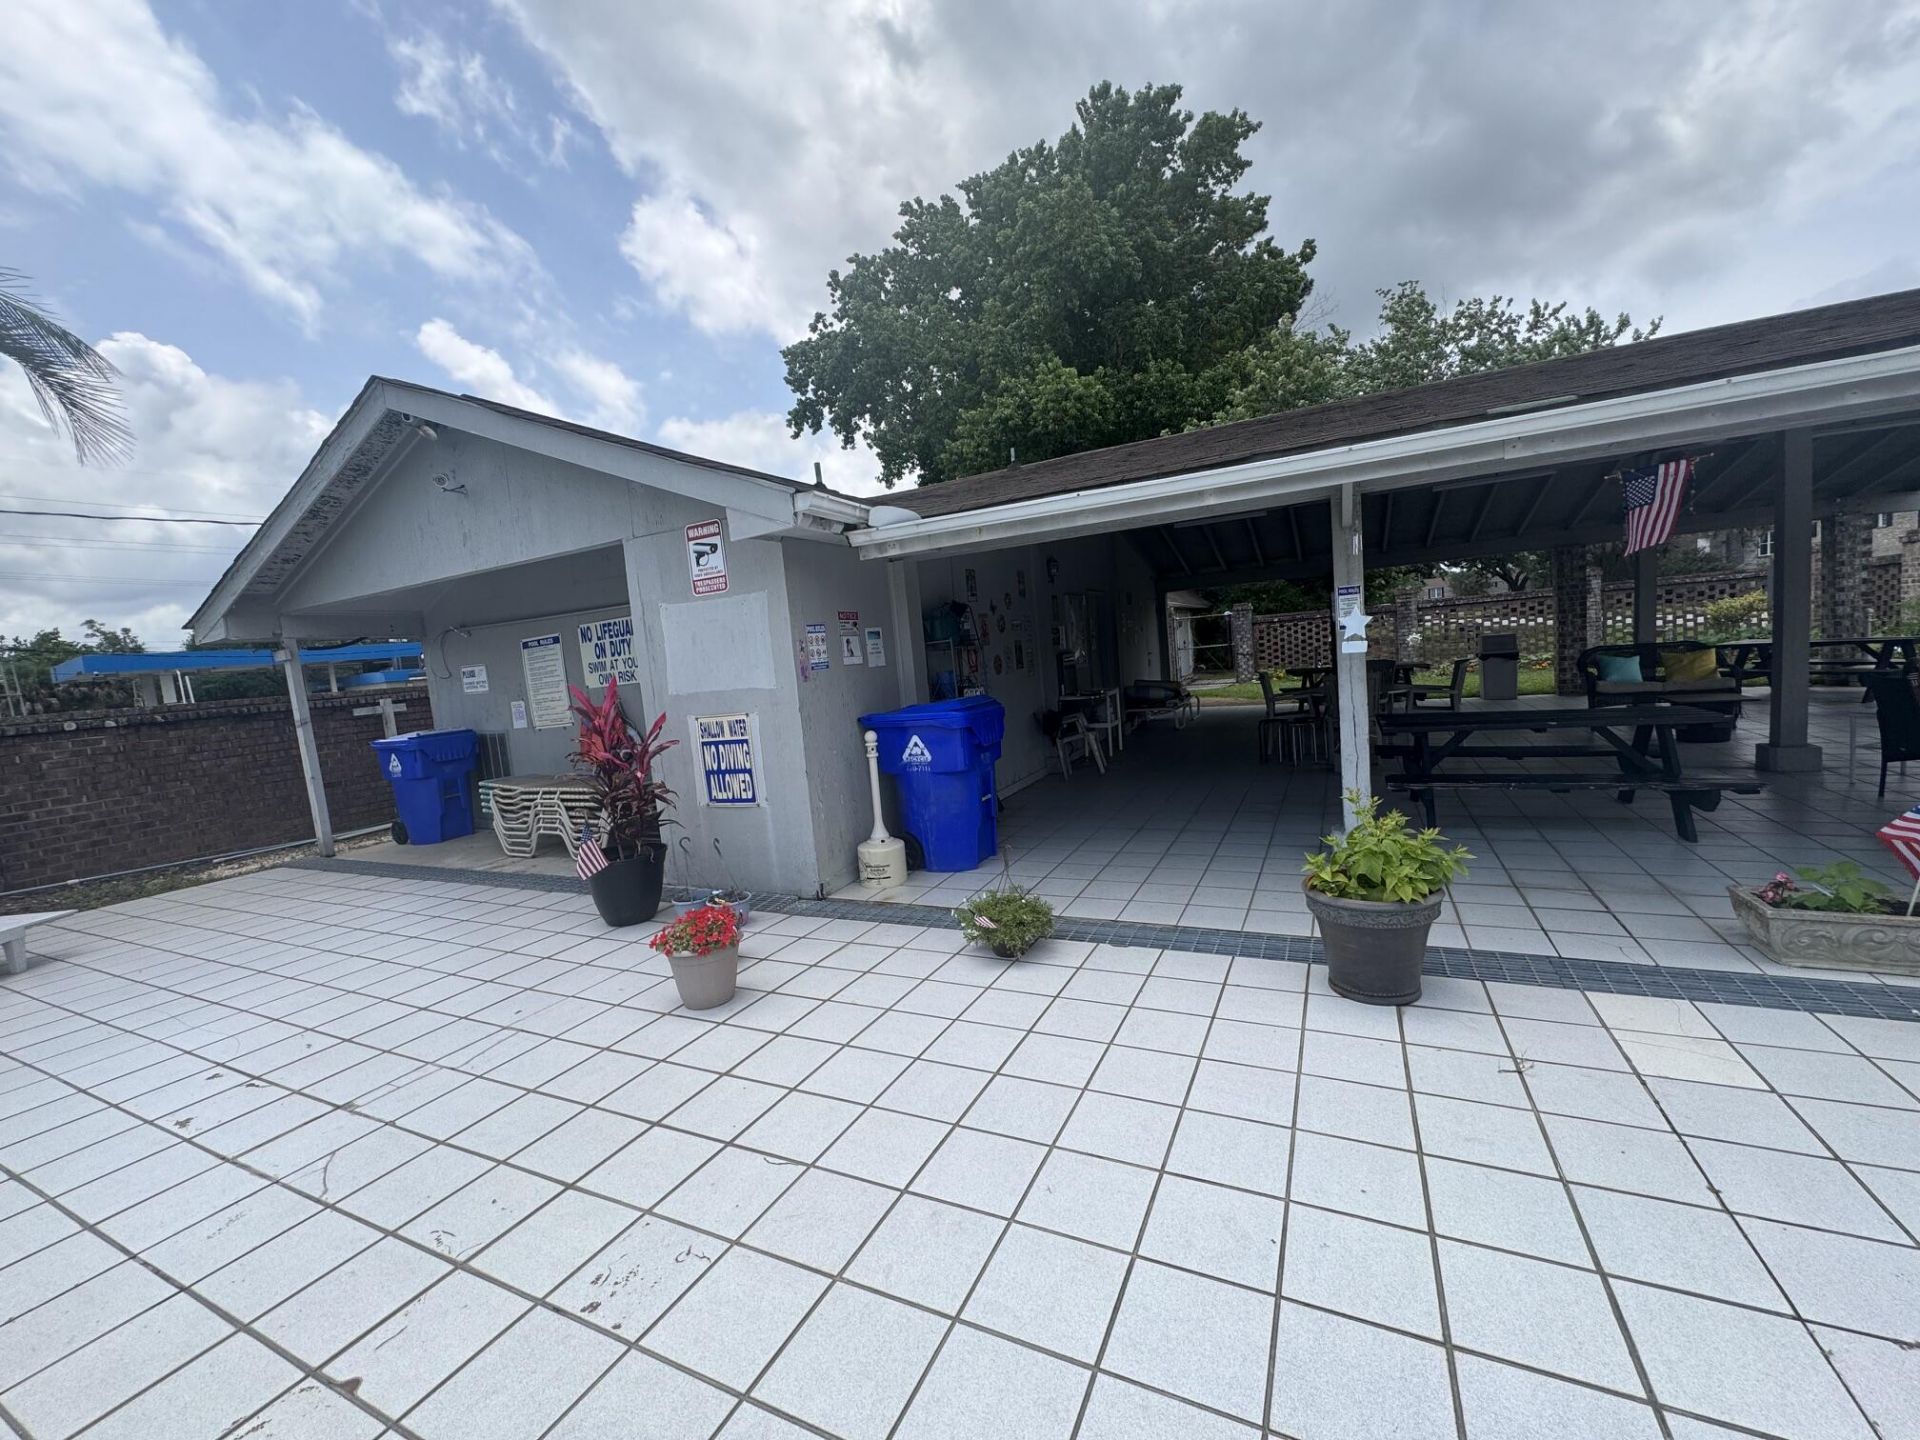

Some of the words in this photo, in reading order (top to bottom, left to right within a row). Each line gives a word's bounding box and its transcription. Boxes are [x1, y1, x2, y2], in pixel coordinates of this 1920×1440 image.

[687, 523, 719, 538] WARNING
[580, 625, 593, 643] NO
[595, 618, 634, 641] LIFEGUA
[595, 642, 607, 659] ON
[610, 638, 631, 657] DUTY
[588, 660, 607, 673] SWIM
[610, 658, 619, 671] AT
[622, 657, 639, 669] YOU
[618, 669, 637, 683] RISK
[699, 720, 726, 739] SHALLOW
[727, 719, 747, 737] WATER
[703, 744, 718, 771] NO
[718, 742, 751, 770] DIVING
[710, 773, 753, 799] ALLOWED
